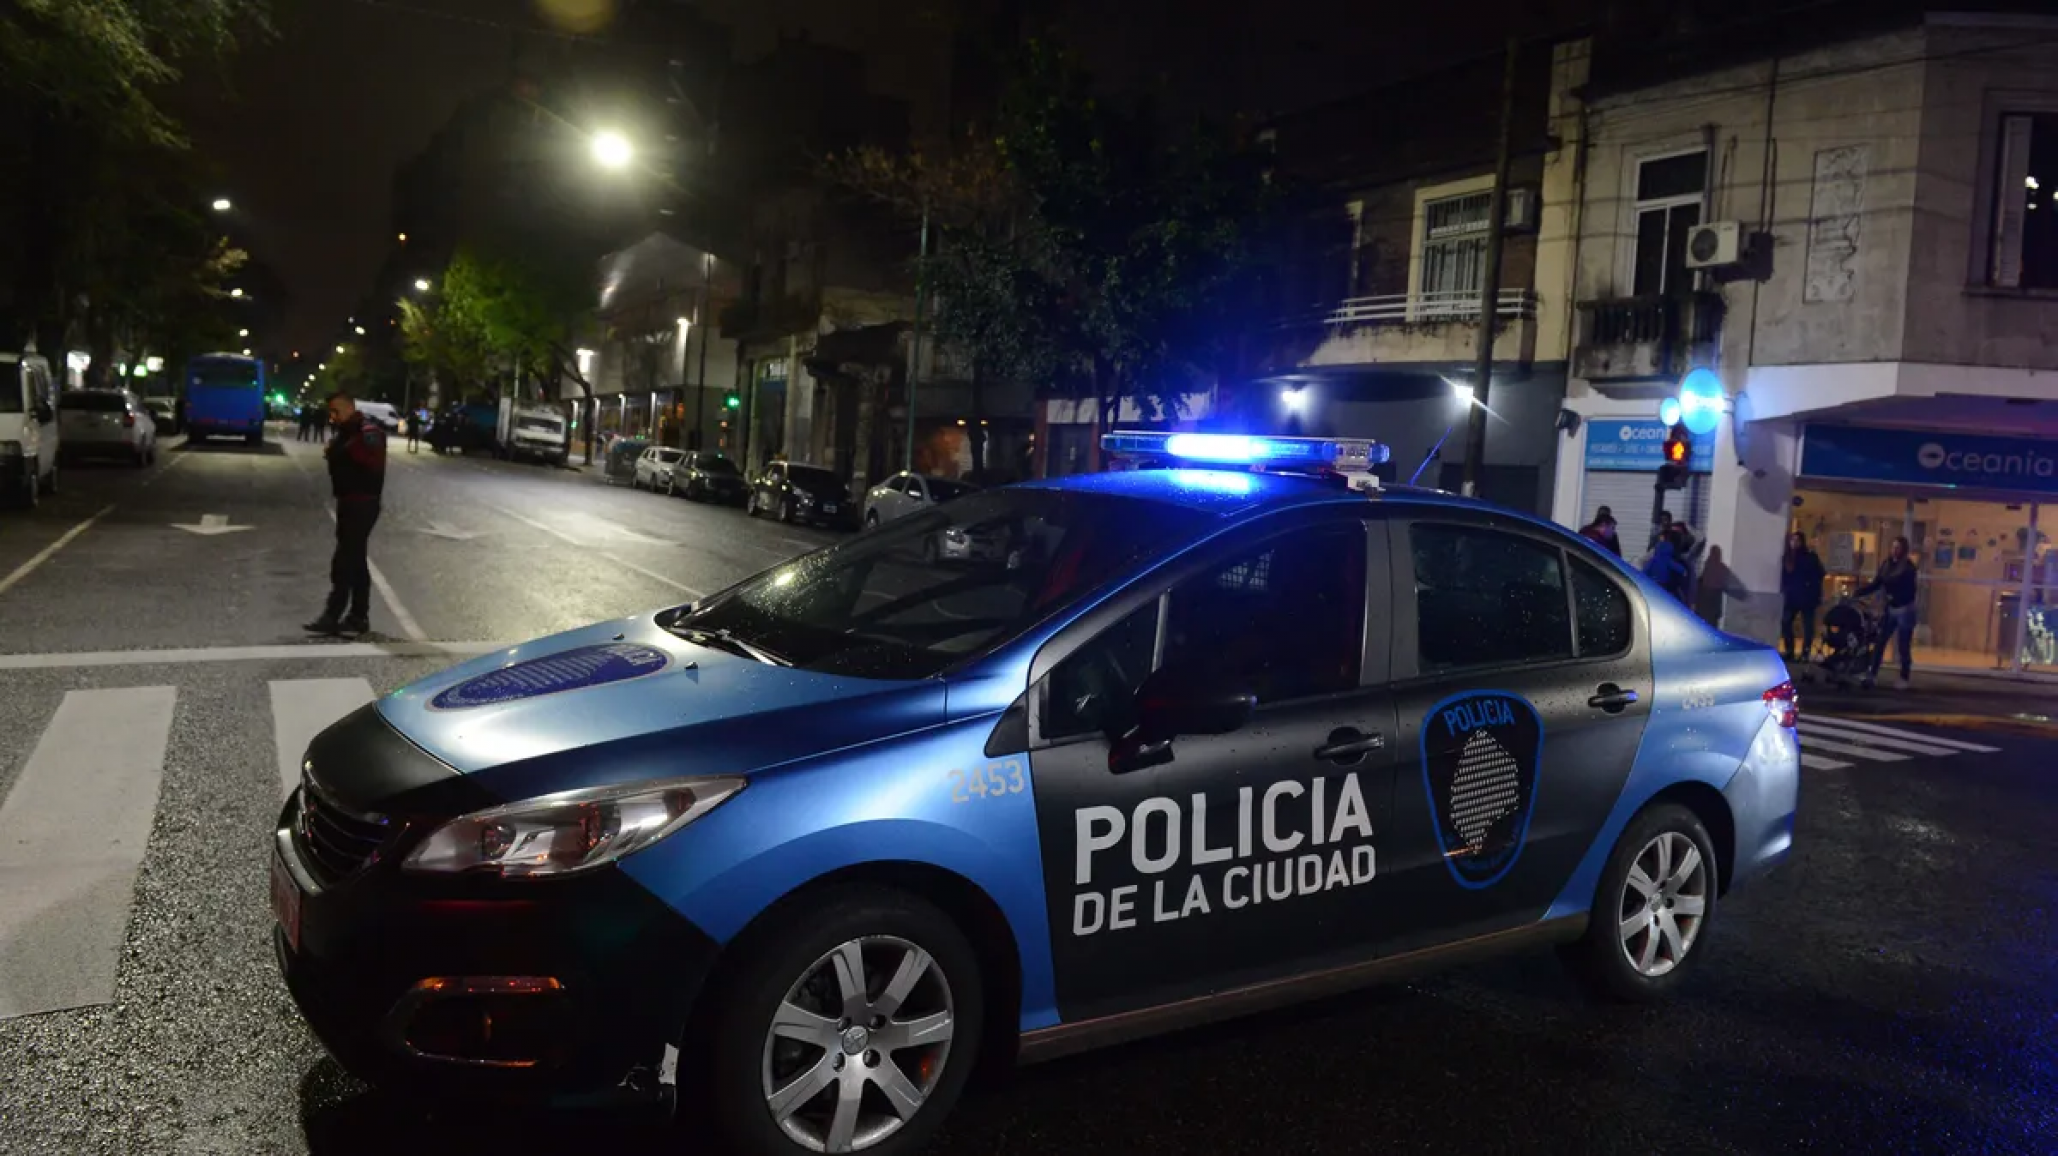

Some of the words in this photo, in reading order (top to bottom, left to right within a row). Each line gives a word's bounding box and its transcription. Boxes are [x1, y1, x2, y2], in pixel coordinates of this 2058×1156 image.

[1619, 425, 1669, 441] Ocean
[1918, 443, 2054, 476] Oceania
[1444, 699, 1515, 736] POLICIA
[947, 760, 1025, 804] 2453
[1075, 772, 1374, 886] POLICIA
[1073, 884, 1138, 936] DE
[1153, 874, 1211, 923] LA
[1223, 844, 1377, 910] CIUDAD
